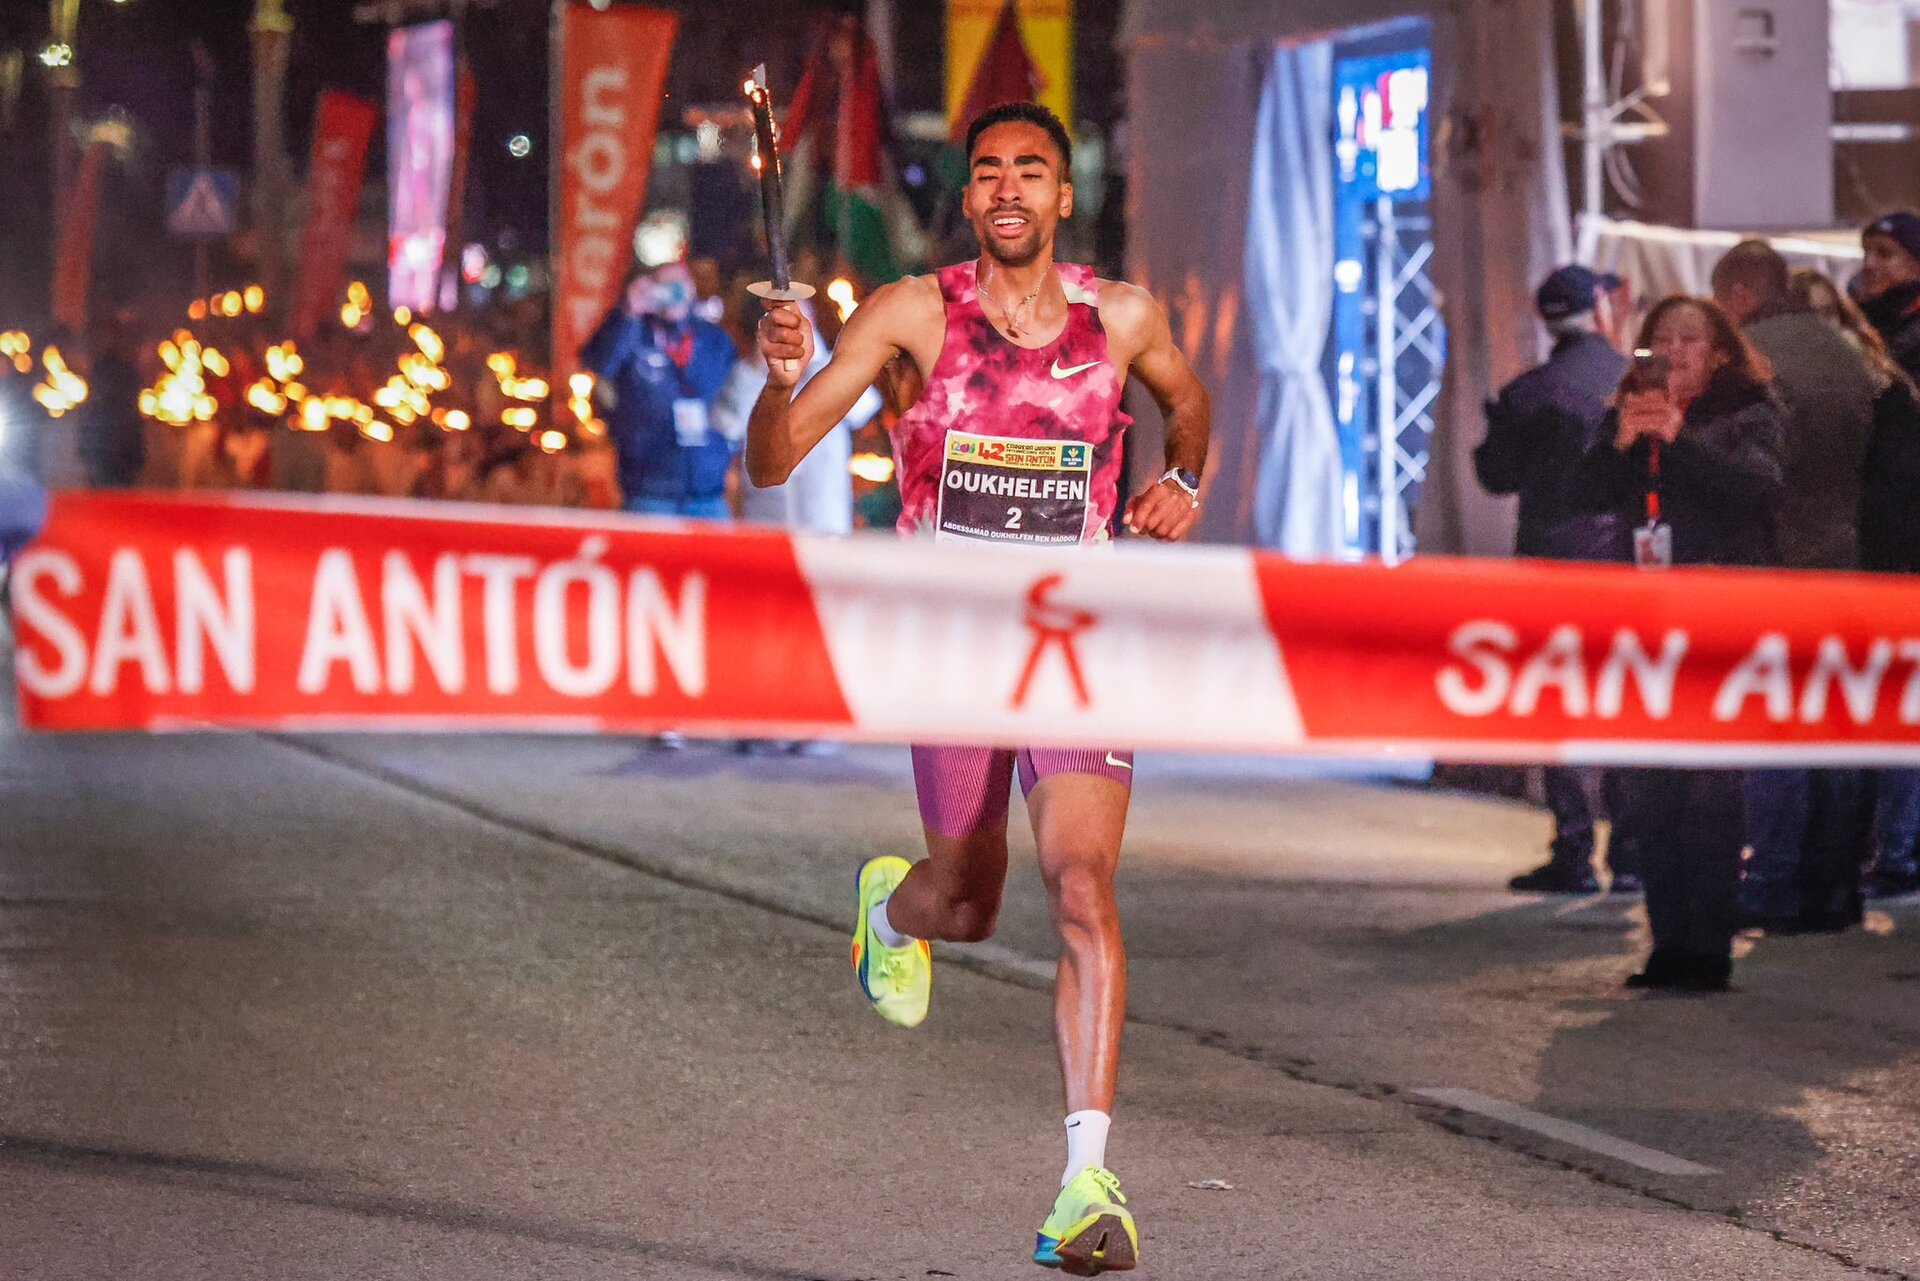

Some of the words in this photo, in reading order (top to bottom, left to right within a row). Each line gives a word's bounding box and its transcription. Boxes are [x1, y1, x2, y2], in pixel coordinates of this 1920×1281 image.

[978, 442, 1005, 461] 42
[946, 470, 1084, 500] OUKHELFEN
[1004, 506, 1022, 529] 2
[943, 521, 989, 536] ABDESSAMAD
[990, 530, 1033, 541] OUKHELFEN
[12, 543, 256, 699] SAN
[296, 534, 708, 699] ANTÓN
[1435, 619, 1690, 721] SAN
